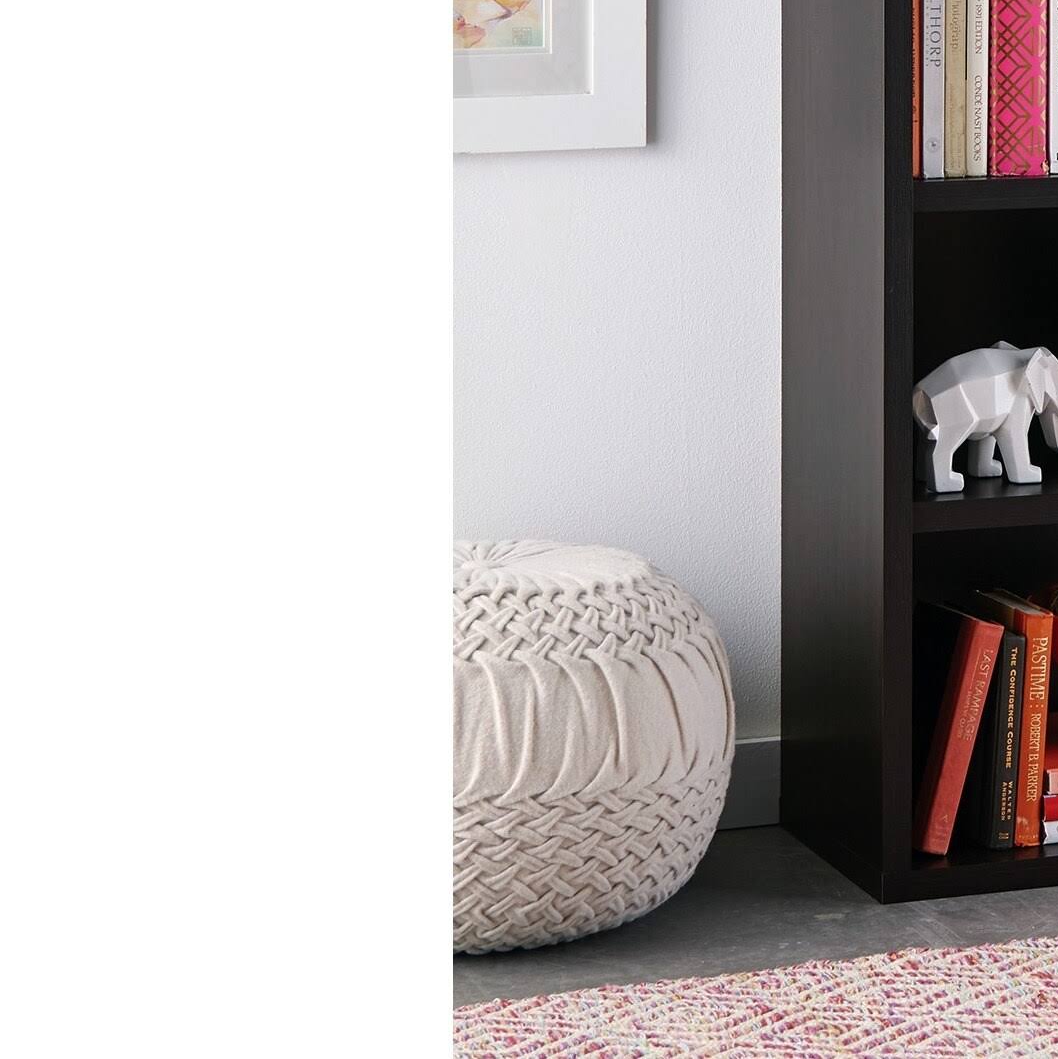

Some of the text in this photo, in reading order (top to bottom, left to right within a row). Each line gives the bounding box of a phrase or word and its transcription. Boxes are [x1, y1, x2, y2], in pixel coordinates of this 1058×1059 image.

[975, 4, 984, 19] 1991
[975, 20, 983, 54] EDITION
[974, 107, 983, 131] NAST
[973, 132, 983, 163] BOOKS
[1029, 637, 1049, 701] PASTIME
[963, 679, 987, 741] RAMPAGE
[1005, 647, 1018, 769] THE CONFIDENCE COURSE
[1028, 713, 1042, 751] ROBERT
[1026, 763, 1039, 803] PARKER
